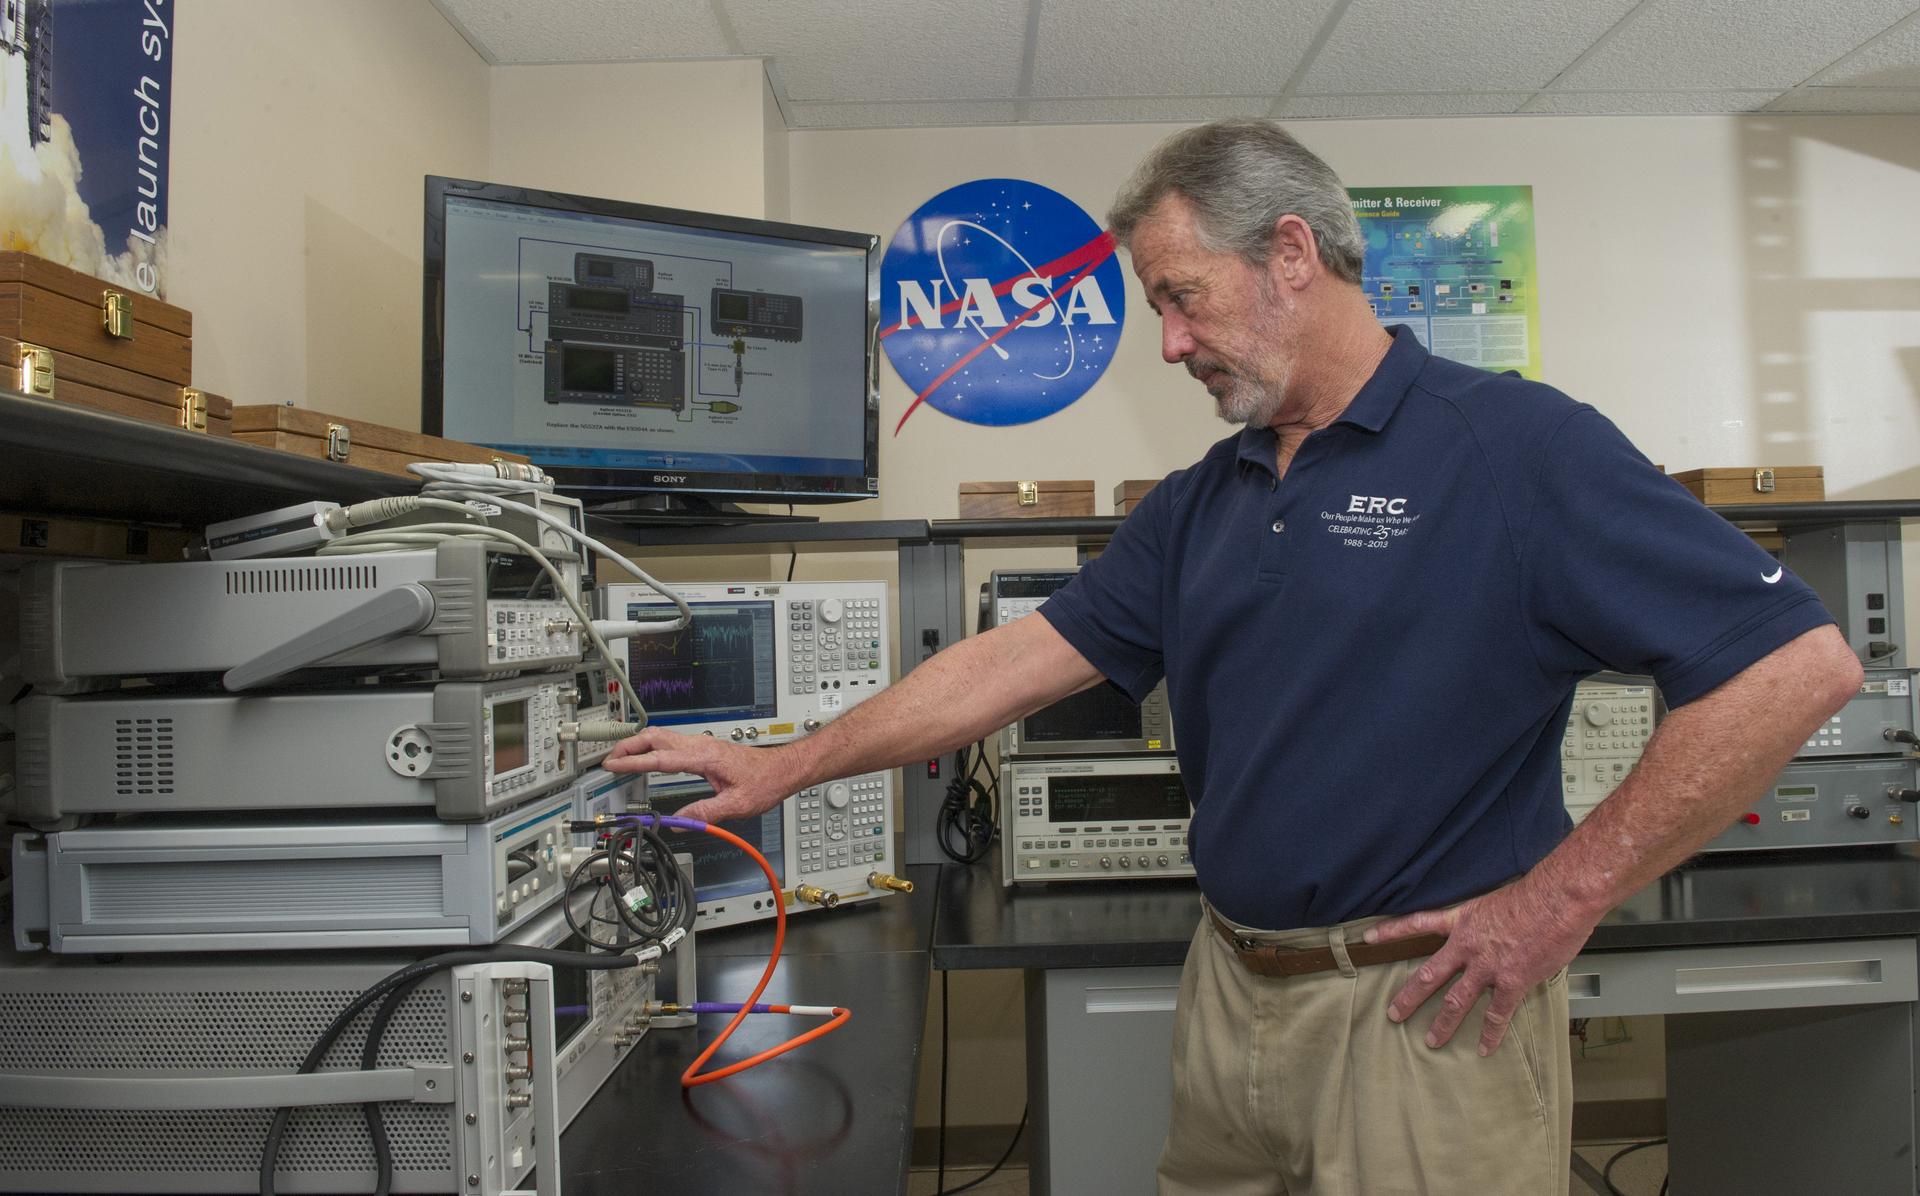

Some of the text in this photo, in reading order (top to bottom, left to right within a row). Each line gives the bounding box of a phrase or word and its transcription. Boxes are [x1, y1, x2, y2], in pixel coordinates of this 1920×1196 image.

[142, 0, 168, 61] sy
[130, 75, 160, 245] launch
[1384, 197, 1393, 208] &
[1396, 196, 1442, 208] Receiver
[897, 275, 1117, 330] NASA
[653, 475, 687, 484] SONY
[1347, 494, 1407, 514] ERC
[1321, 511, 1334, 520] Our
[1335, 513, 1358, 523] People
[1358, 515, 1376, 523] Make
[1385, 516, 1401, 524] Who
[1328, 524, 1372, 535] CELEBRATING
[1373, 524, 1391, 540] 25
